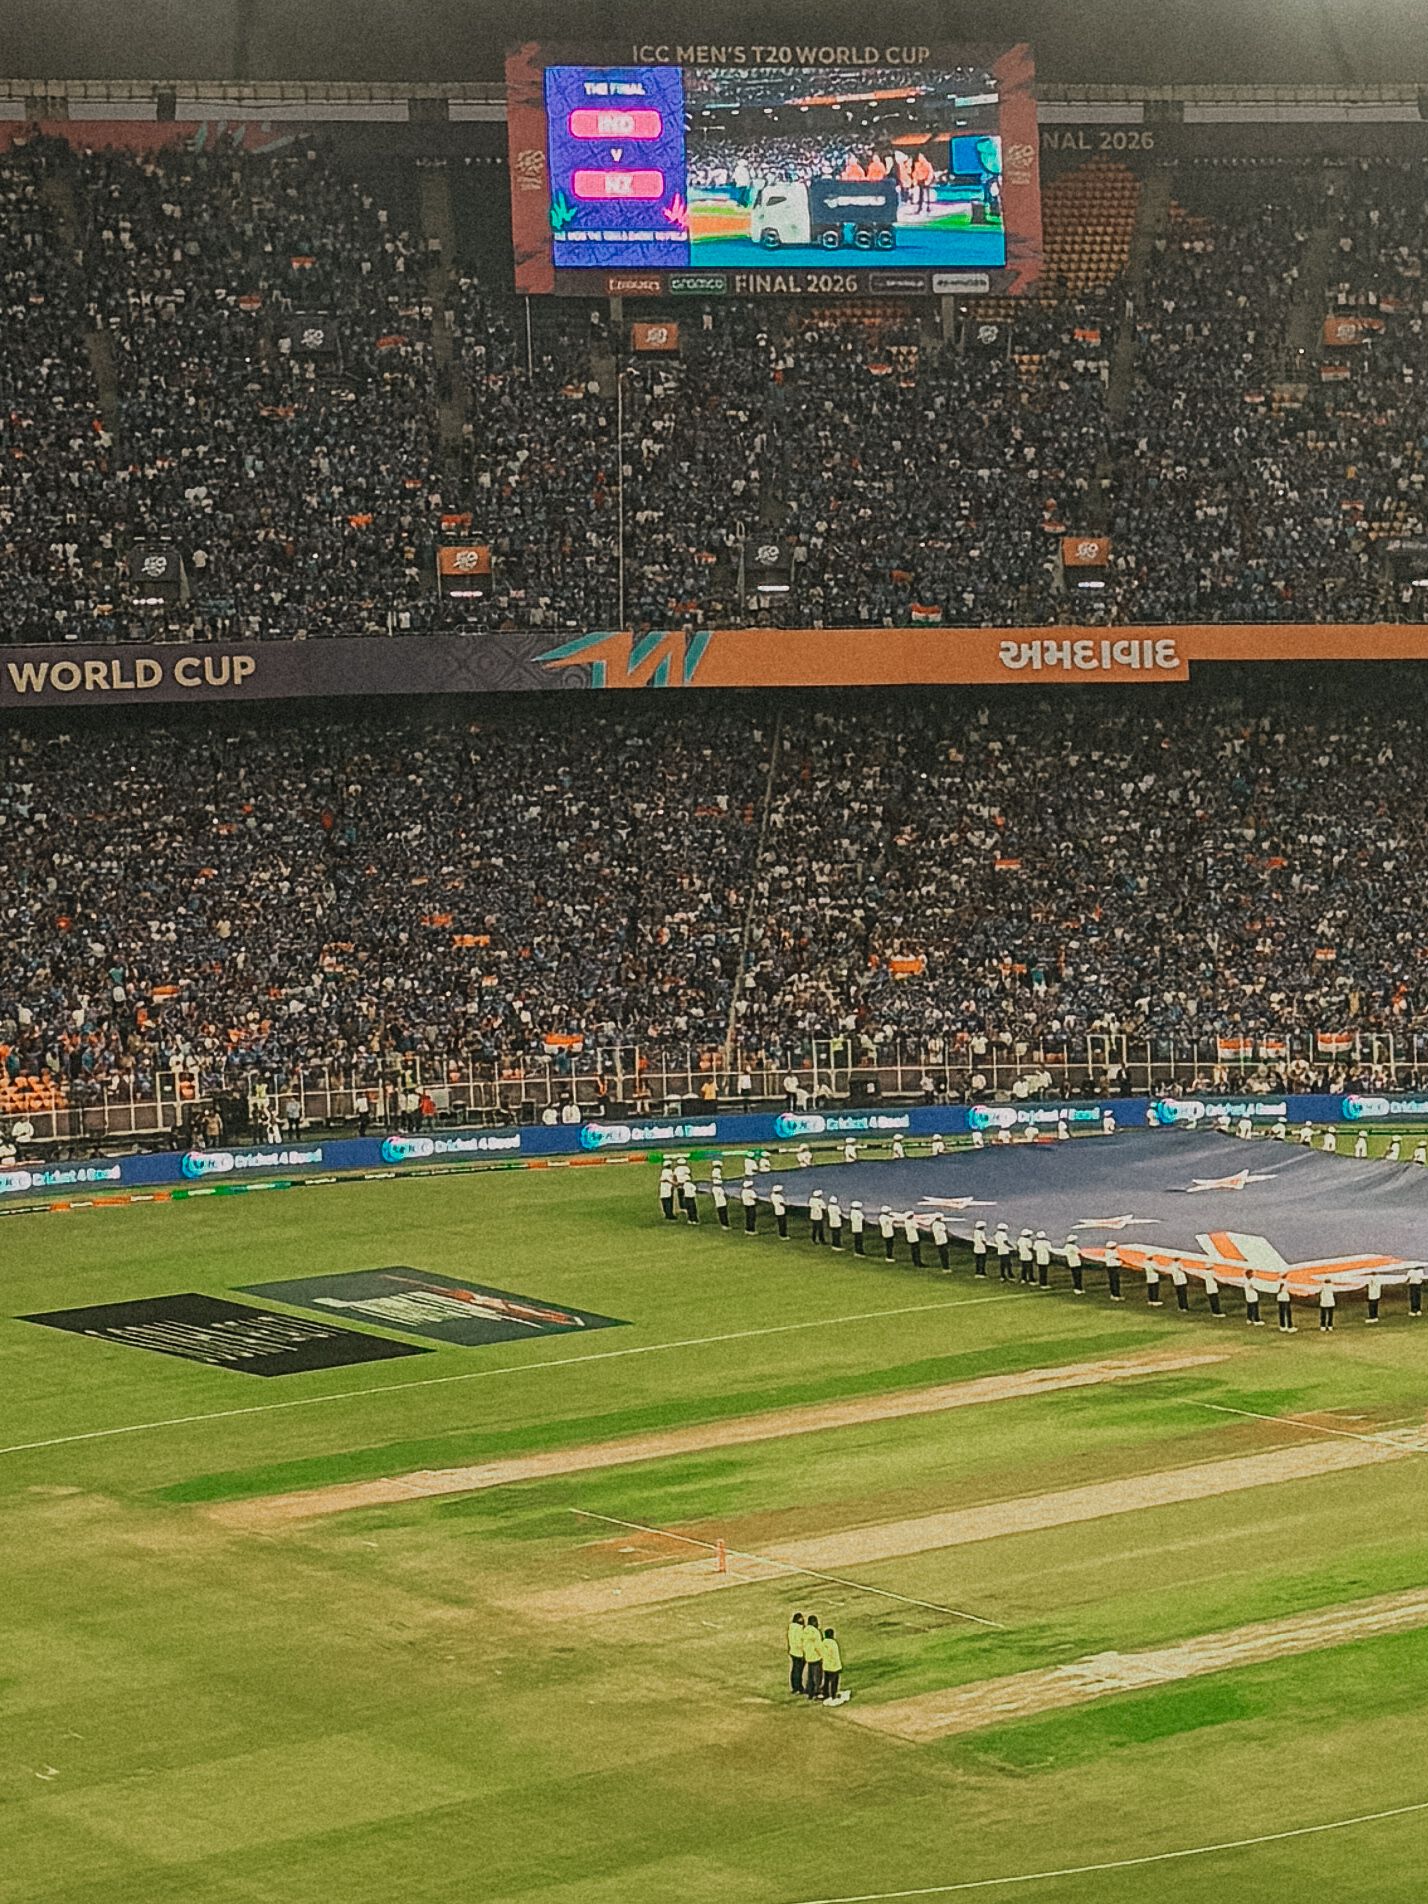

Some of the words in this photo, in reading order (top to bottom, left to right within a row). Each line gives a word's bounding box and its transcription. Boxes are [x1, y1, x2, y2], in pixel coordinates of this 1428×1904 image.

[633, 46, 669, 63] ICC
[677, 46, 746, 64] MEN'S
[752, 46, 792, 64] T20
[796, 47, 879, 64] WORLD
[885, 47, 930, 64] CUP
[1100, 131, 1155, 151] 2026
[736, 274, 800, 293] FINAL
[807, 274, 858, 293] 2026
[7, 657, 164, 696] WORLD
[174, 655, 256, 690] CUP
